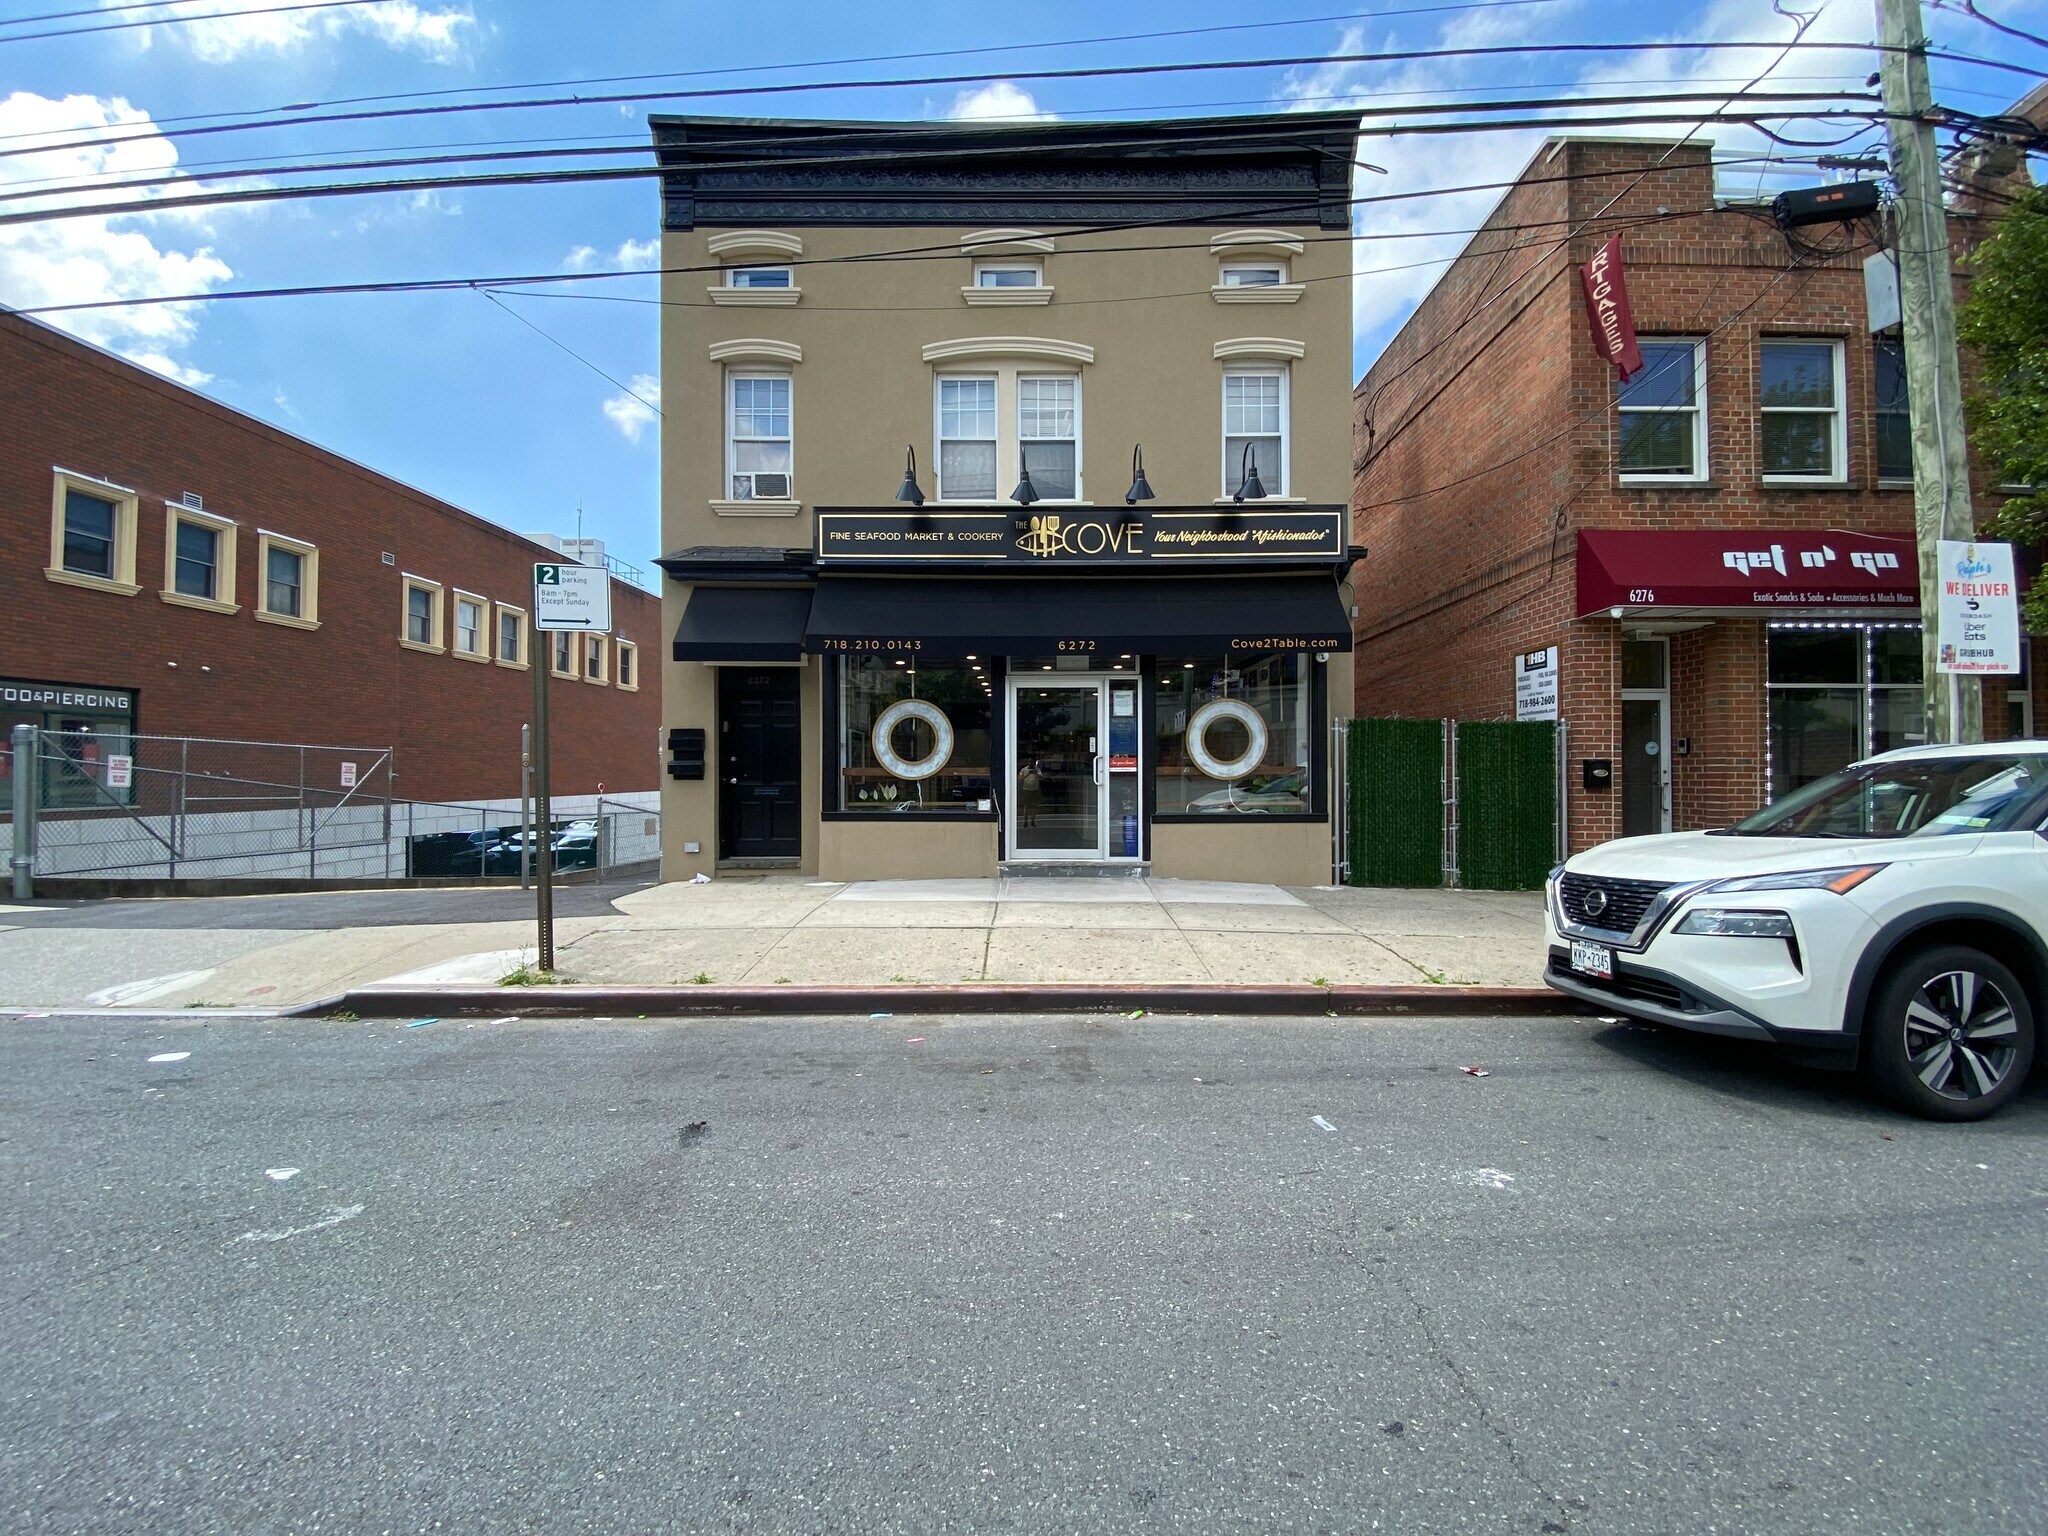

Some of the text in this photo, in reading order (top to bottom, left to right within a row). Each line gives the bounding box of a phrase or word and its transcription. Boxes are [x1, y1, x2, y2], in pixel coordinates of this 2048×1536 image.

[1015, 521, 1028, 529] THE
[830, 532, 1004, 541] FINE SEAFOOD MARKET & COOKERY
[1062, 523, 1143, 554] COVE
[1154, 530, 1176, 543] Your
[1176, 530, 1250, 546] Neighborhood
[561, 568, 577, 576] hour
[1956, 559, 1992, 579] Ralph's
[542, 566, 554, 584] 2
[563, 590, 578, 598] 7pm
[1946, 582, 2009, 596] WE DELIVER
[1629, 589, 1655, 602] 6276
[1753, 592, 1914, 603] Exotic Snacks & Soda Accessories & Much More
[541, 597, 590, 607] Except Sunday
[1964, 622, 1986, 631] Uber
[1964, 631, 1986, 640] Eats
[824, 639, 922, 650] 718.210.0143
[1058, 640, 1096, 650] 6272
[1231, 638, 1338, 649] Cove2Table.com
[1526, 651, 1545, 665] 1HB
[1960, 648, 1995, 657] GRUBHUB
[1519, 695, 1556, 709] 718-984-2600
[1573, 948, 1586, 964] KKP
[1591, 952, 1608, 970] 2345
